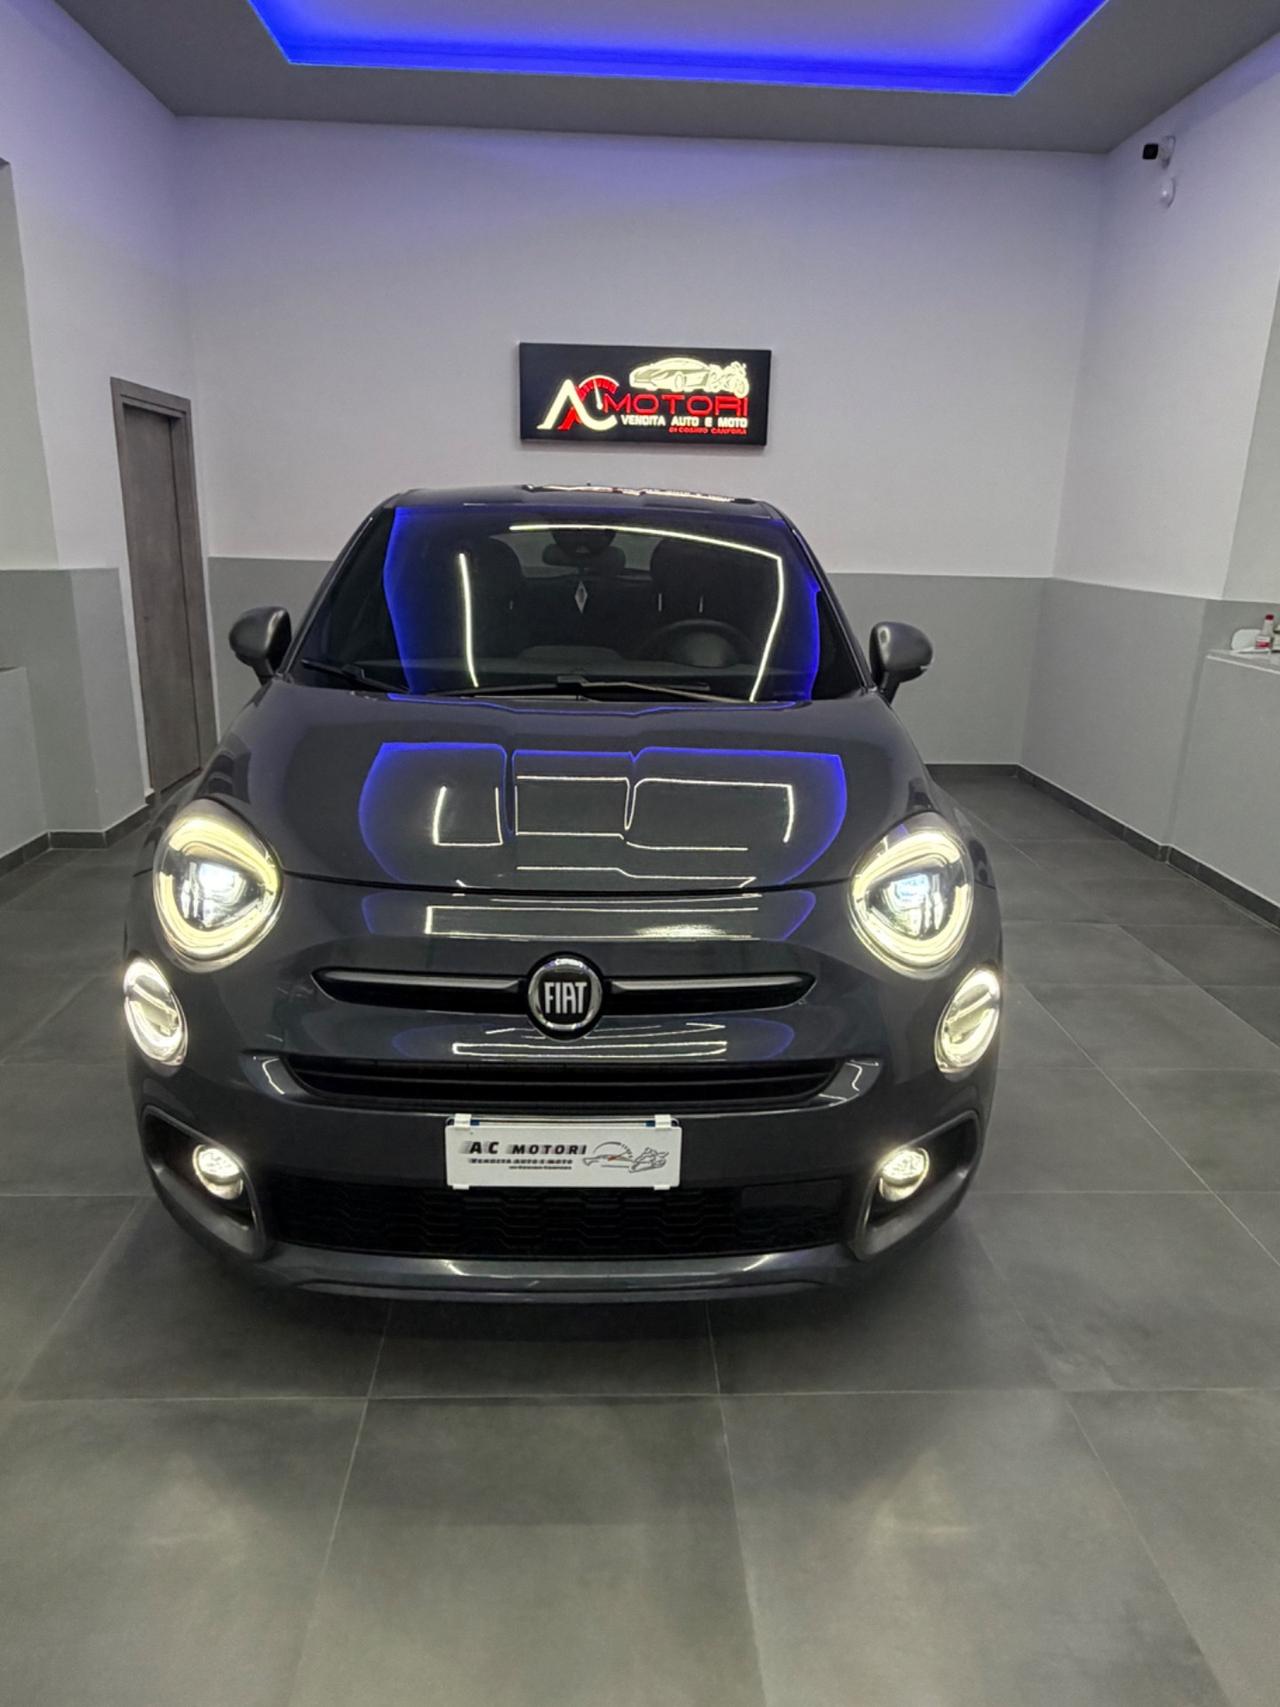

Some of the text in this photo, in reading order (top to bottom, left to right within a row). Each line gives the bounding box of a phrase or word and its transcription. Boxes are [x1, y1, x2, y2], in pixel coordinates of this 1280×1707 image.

[603, 393, 748, 417] MOTORI
[620, 414, 748, 428] VENDITA AUTO E MOTO
[544, 981, 587, 1014] FIAT
[510, 1144, 587, 1155] MOTORI
